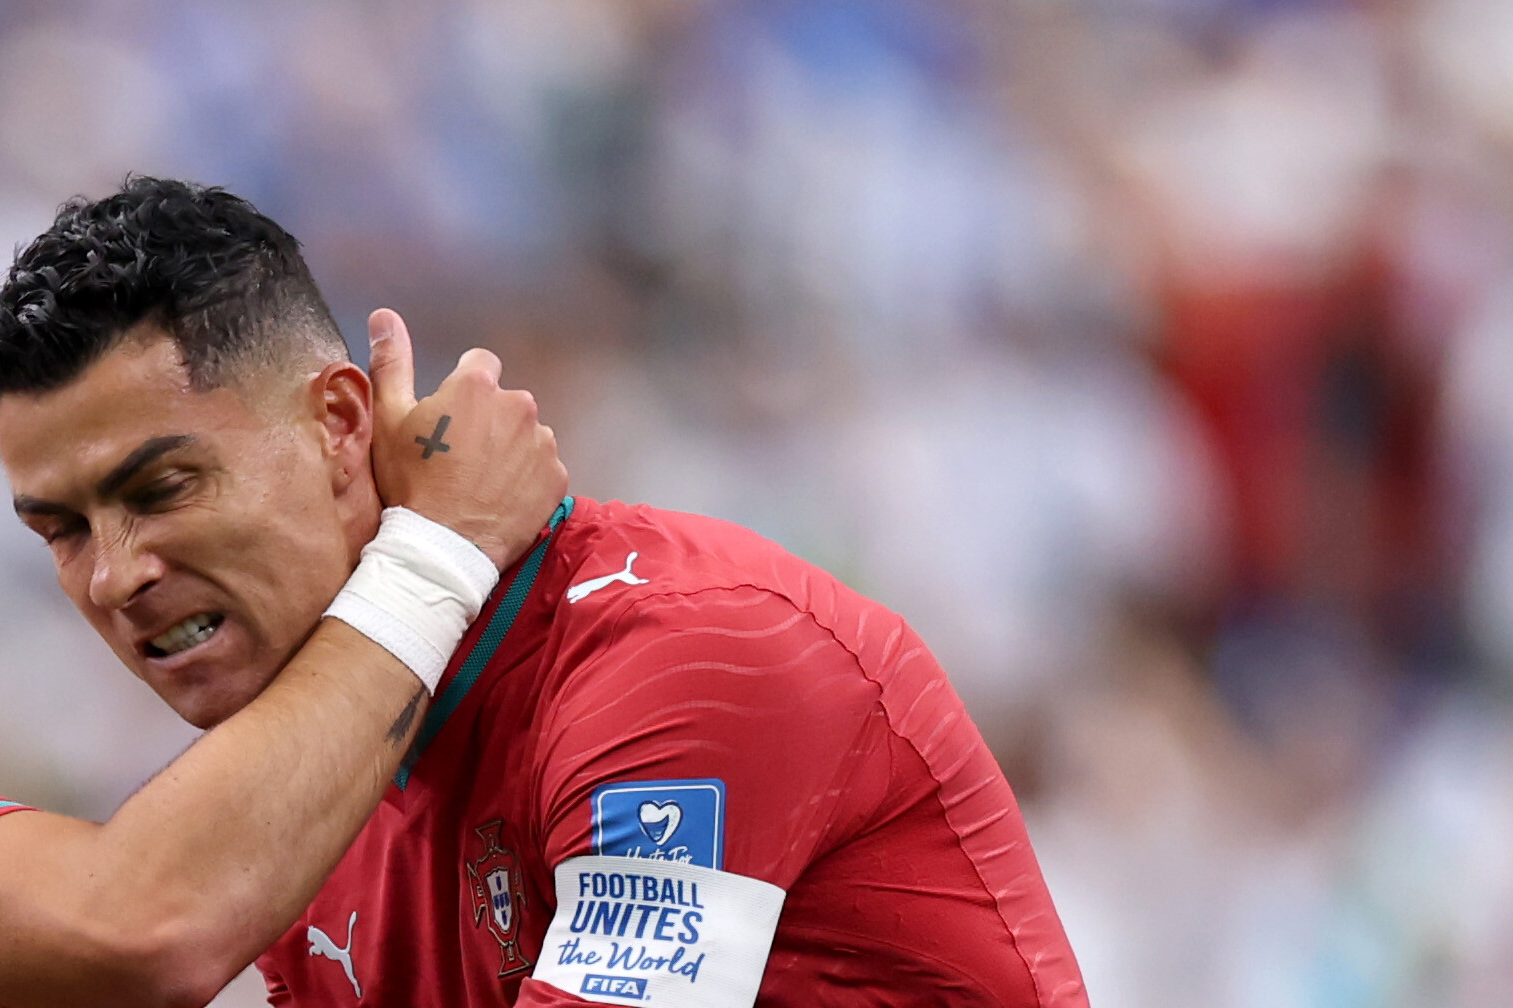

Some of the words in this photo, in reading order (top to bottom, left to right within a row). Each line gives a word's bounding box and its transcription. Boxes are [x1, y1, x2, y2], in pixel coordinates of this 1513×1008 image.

[578, 872, 704, 909] FOOTBALL
[569, 900, 703, 945] UNITES
[557, 937, 602, 966] the
[607, 942, 706, 983] World
[583, 975, 641, 997] FIFA
